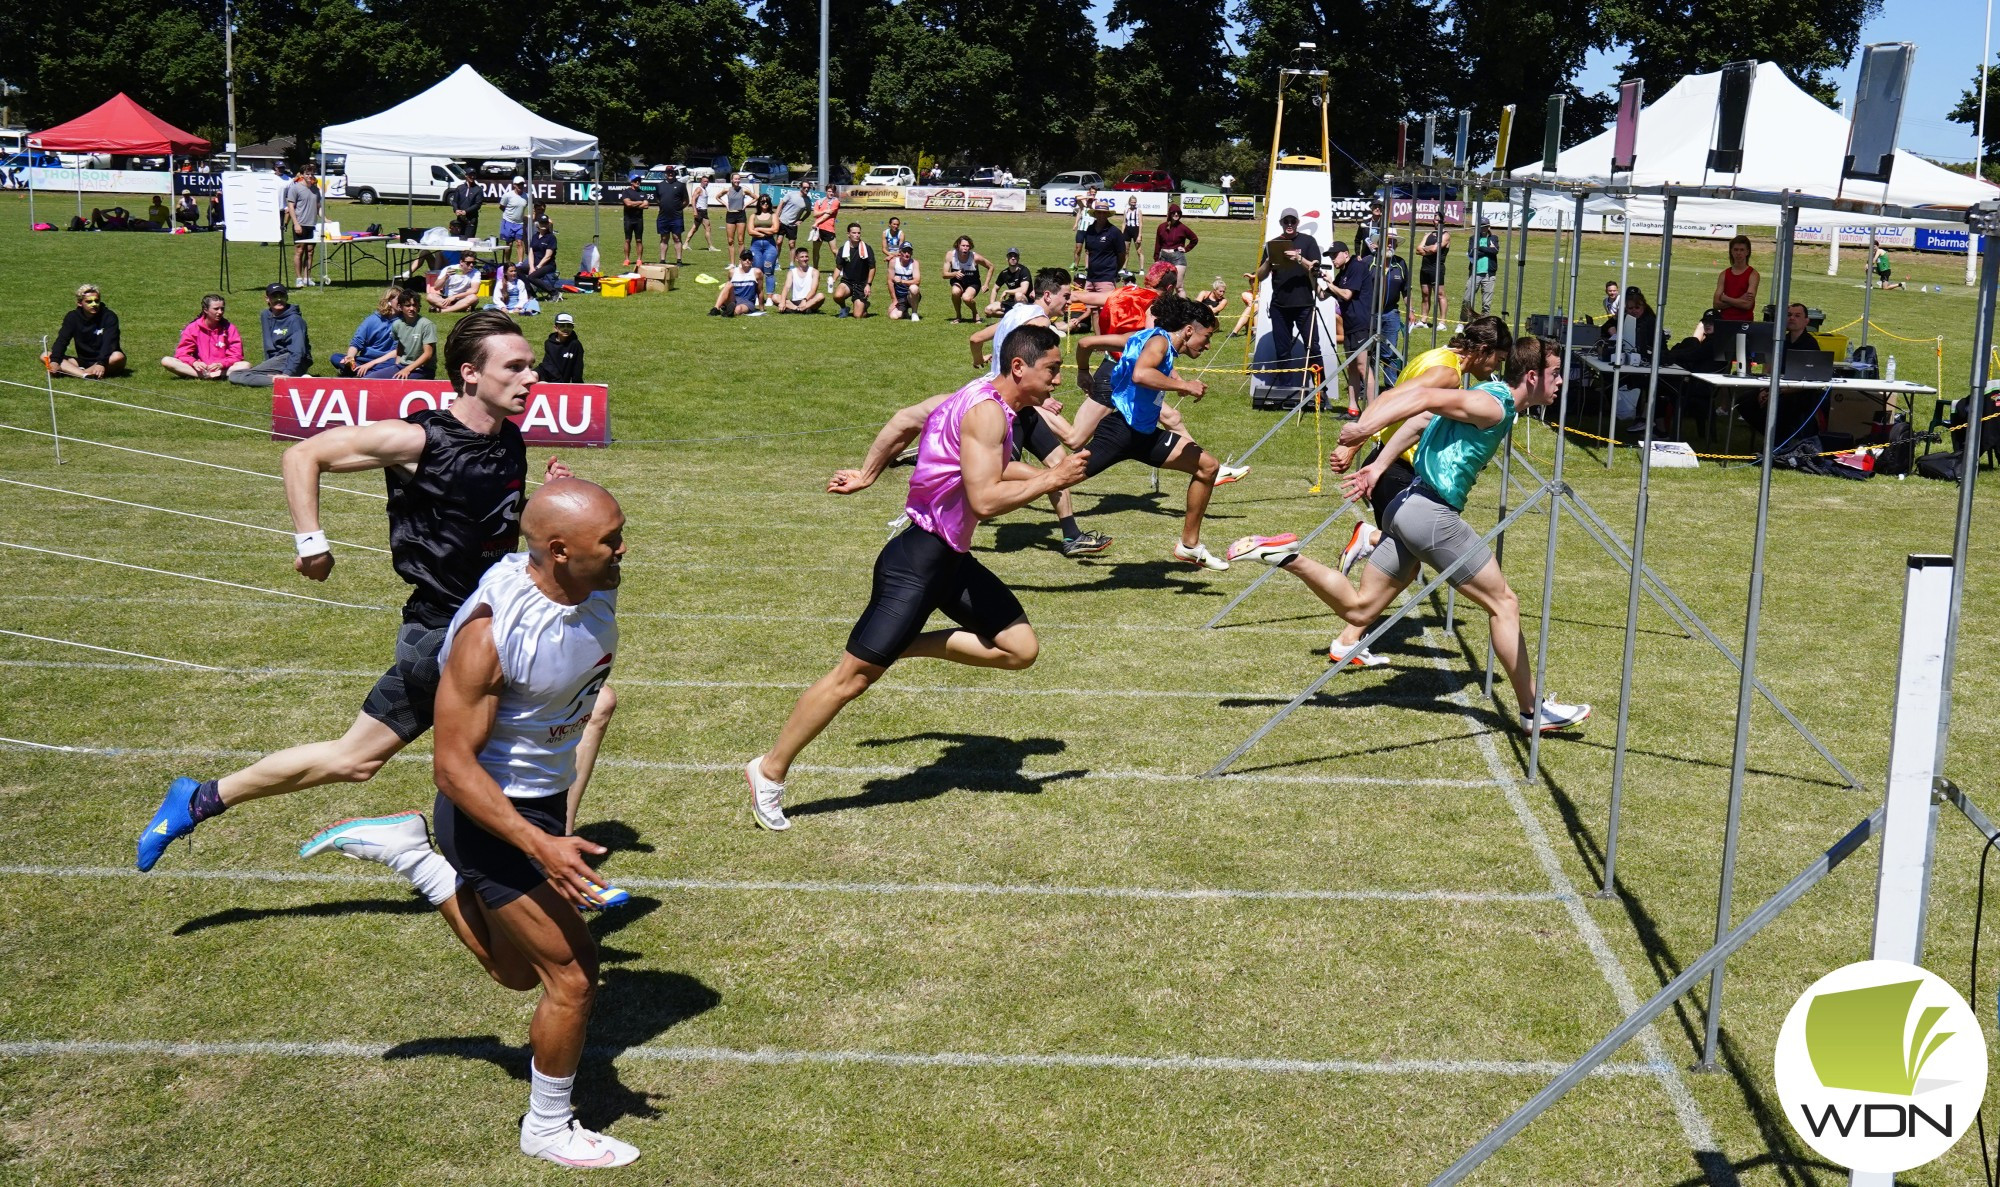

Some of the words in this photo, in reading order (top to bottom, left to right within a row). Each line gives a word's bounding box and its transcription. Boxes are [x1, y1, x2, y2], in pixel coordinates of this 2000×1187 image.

[42, 169, 110, 181] THOMSON
[523, 183, 557, 199] AFE
[850, 189, 899, 199] starprinting
[1393, 202, 1460, 221] COMMERCAL
